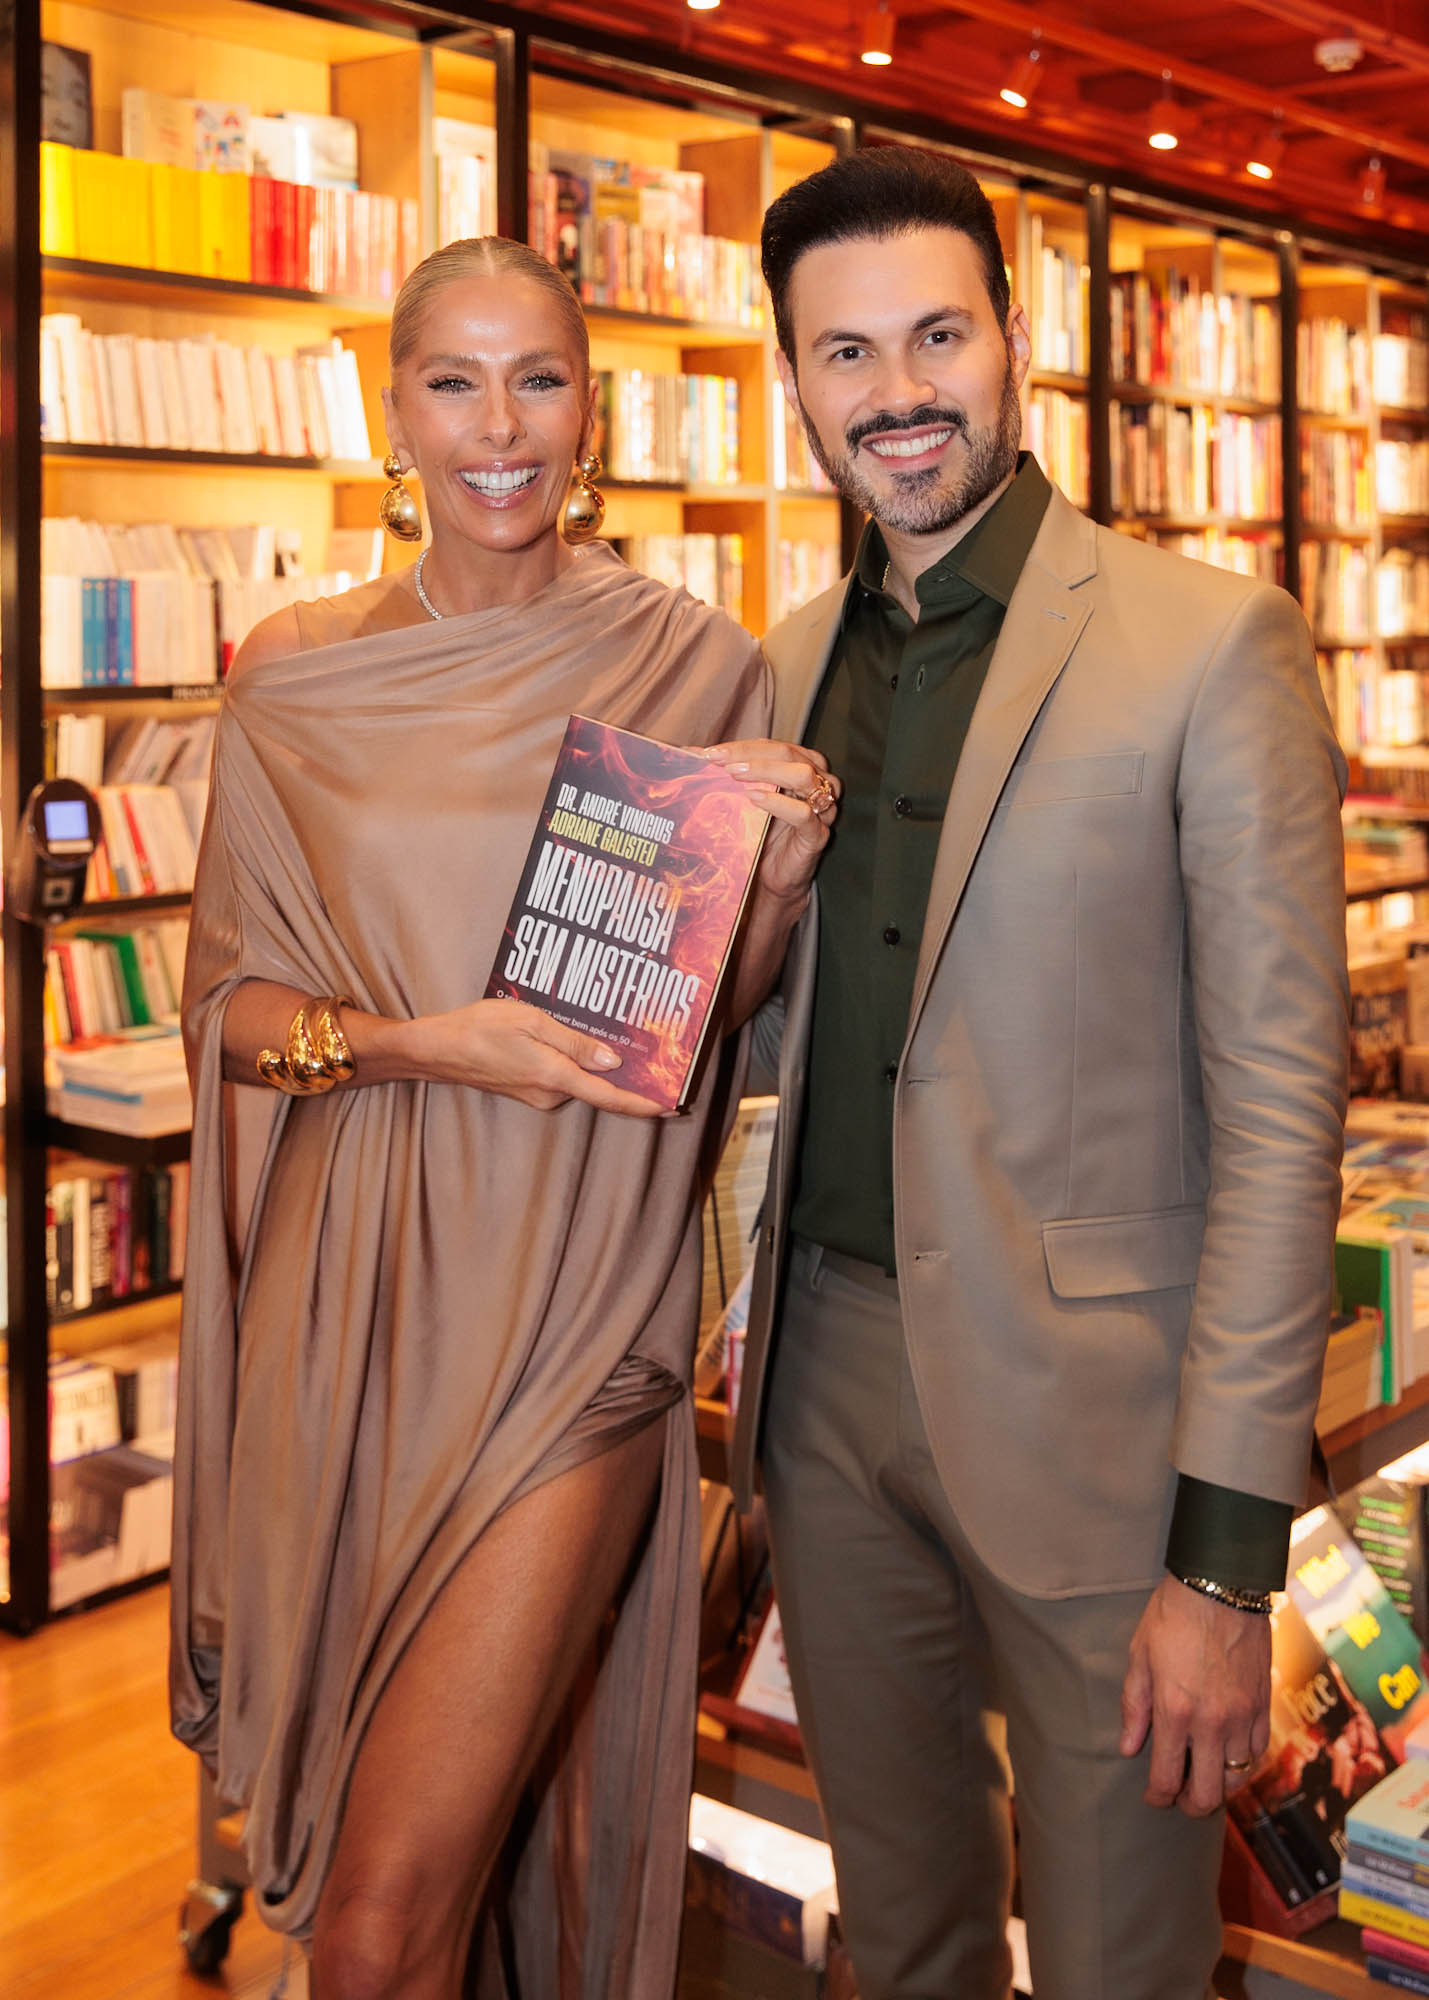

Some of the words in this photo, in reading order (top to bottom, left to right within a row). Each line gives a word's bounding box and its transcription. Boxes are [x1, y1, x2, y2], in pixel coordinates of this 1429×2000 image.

[547, 808, 603, 847] ADRIANE
[600, 826, 659, 867] GALISTEU
[556, 783, 578, 812] DR.
[578, 791, 622, 827] ANDRÉ
[619, 804, 675, 844] VINÍCIUS
[525, 840, 682, 955] MENOPAUSA
[504, 914, 569, 995] SEM
[557, 933, 700, 1041] MISTÉRIOS
[496, 989, 504, 999] O
[552, 1011, 571, 1024] viver
[571, 1017, 588, 1031] bem
[589, 1026, 608, 1039] após
[608, 1033, 618, 1042] os
[619, 1035, 631, 1046] 50
